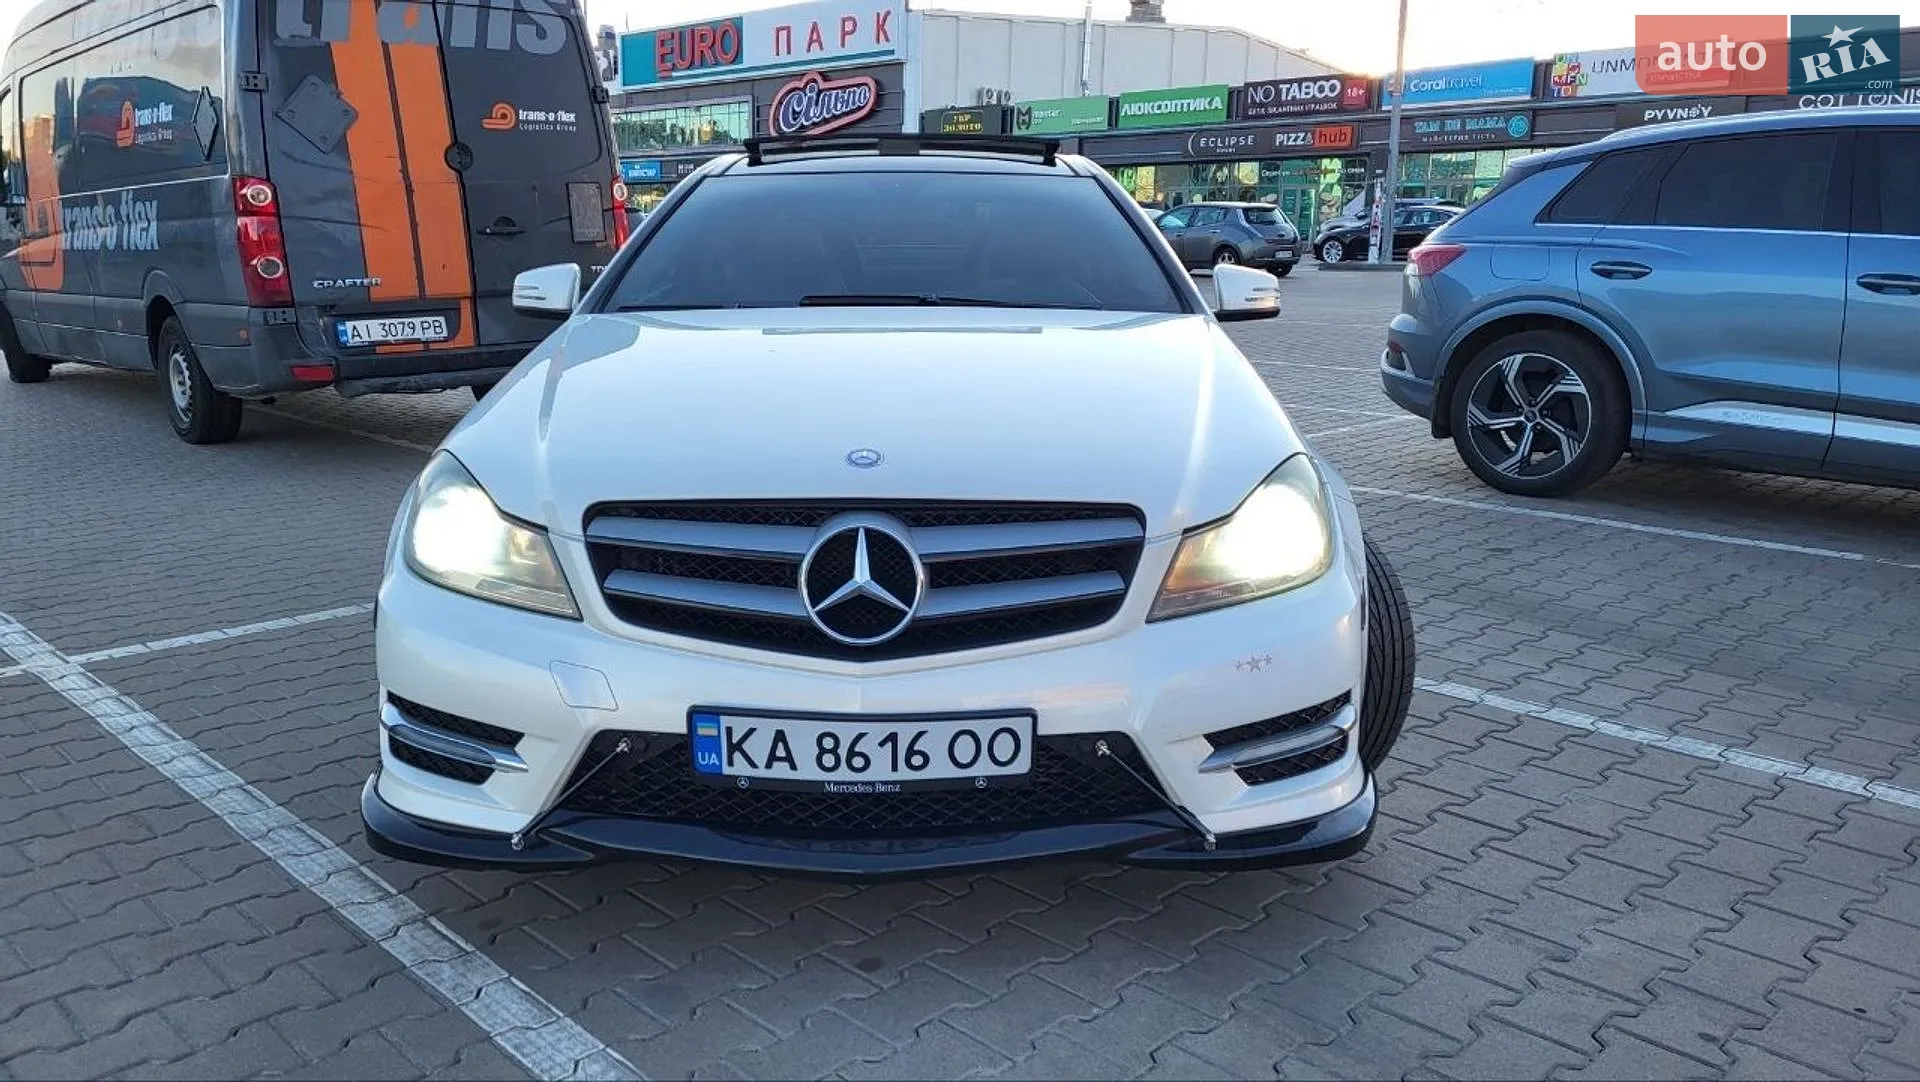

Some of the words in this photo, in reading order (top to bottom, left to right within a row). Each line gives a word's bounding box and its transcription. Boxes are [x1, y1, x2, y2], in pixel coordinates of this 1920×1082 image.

[773, 9, 893, 57] ПАРК
[654, 19, 741, 73] EURO
[1248, 85, 1275, 104] NO
[1279, 79, 1341, 101] TABOO
[1120, 96, 1223, 116] ЛЮКСОПТИКА
[1200, 135, 1255, 147] ECLIPSE
[1318, 127, 1348, 145] hub
[312, 277, 382, 289] CRAFTER
[350, 325, 372, 342] AI
[380, 321, 417, 339] 3079
[420, 320, 444, 336] PB
[697, 752, 719, 766] UA
[725, 726, 798, 772] KA
[815, 730, 930, 774] 8616
[947, 726, 1022, 769] OO
